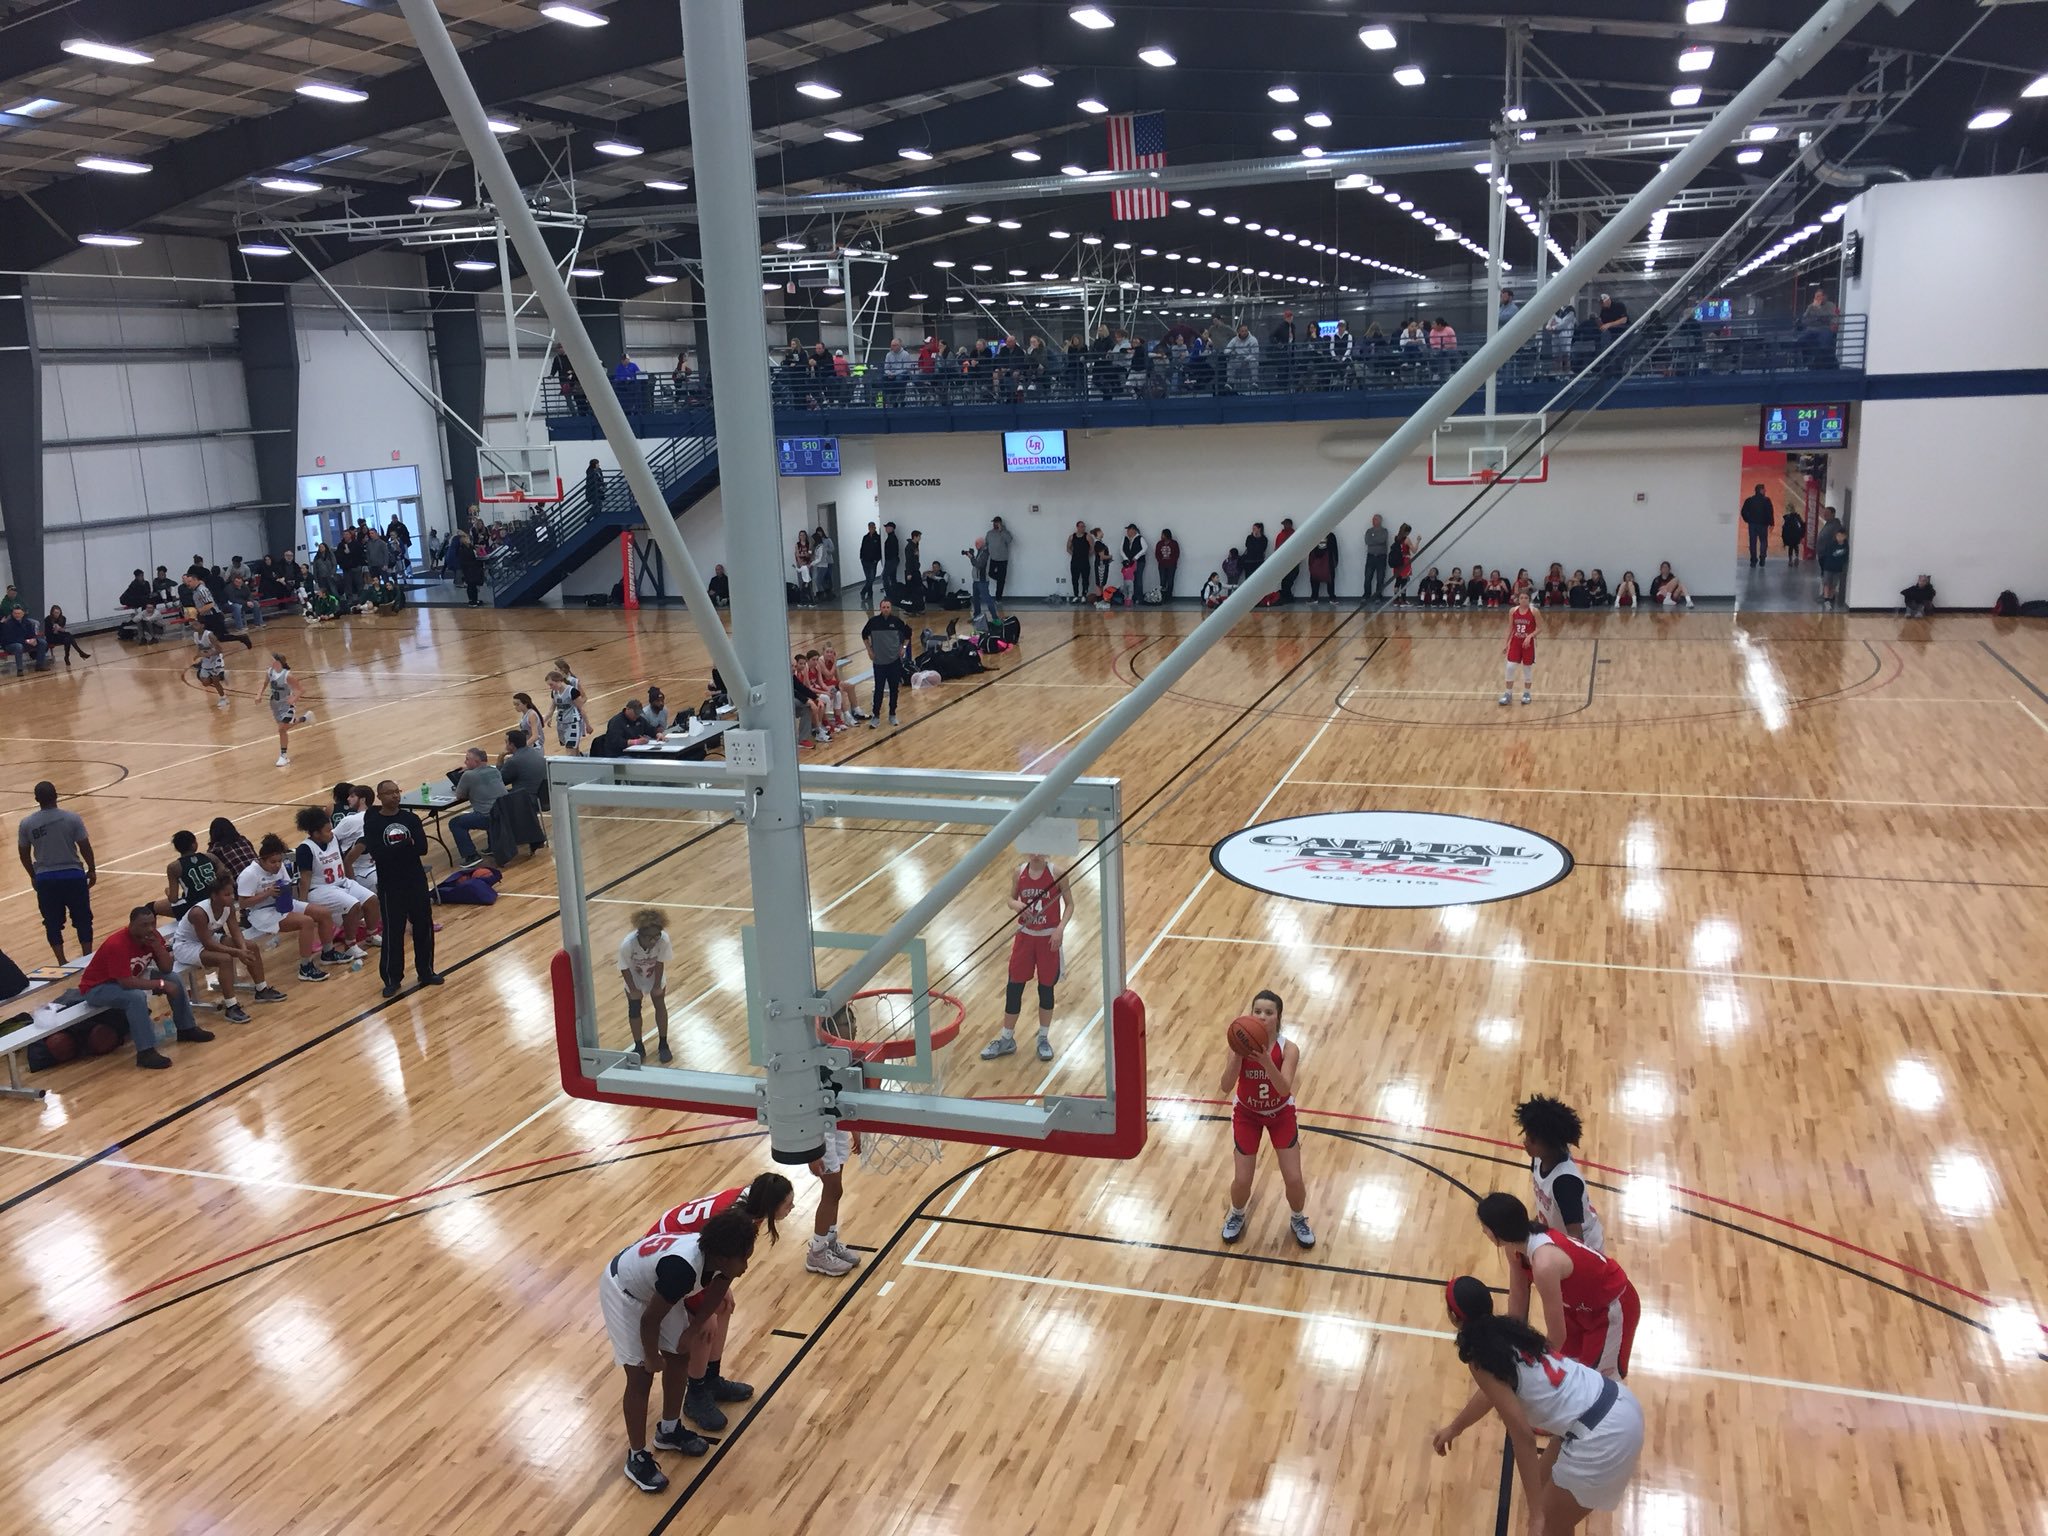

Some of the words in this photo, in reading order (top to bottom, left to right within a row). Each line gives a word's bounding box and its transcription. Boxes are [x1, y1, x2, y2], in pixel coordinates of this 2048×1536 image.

[1798, 410, 1817, 419] 241
[887, 478, 942, 488] RESTROOMS
[1249, 835, 1544, 860] CAPITAL
[1313, 850, 1471, 863] CITY
[188, 862, 218, 892] 15
[1258, 1083, 1270, 1099] 2
